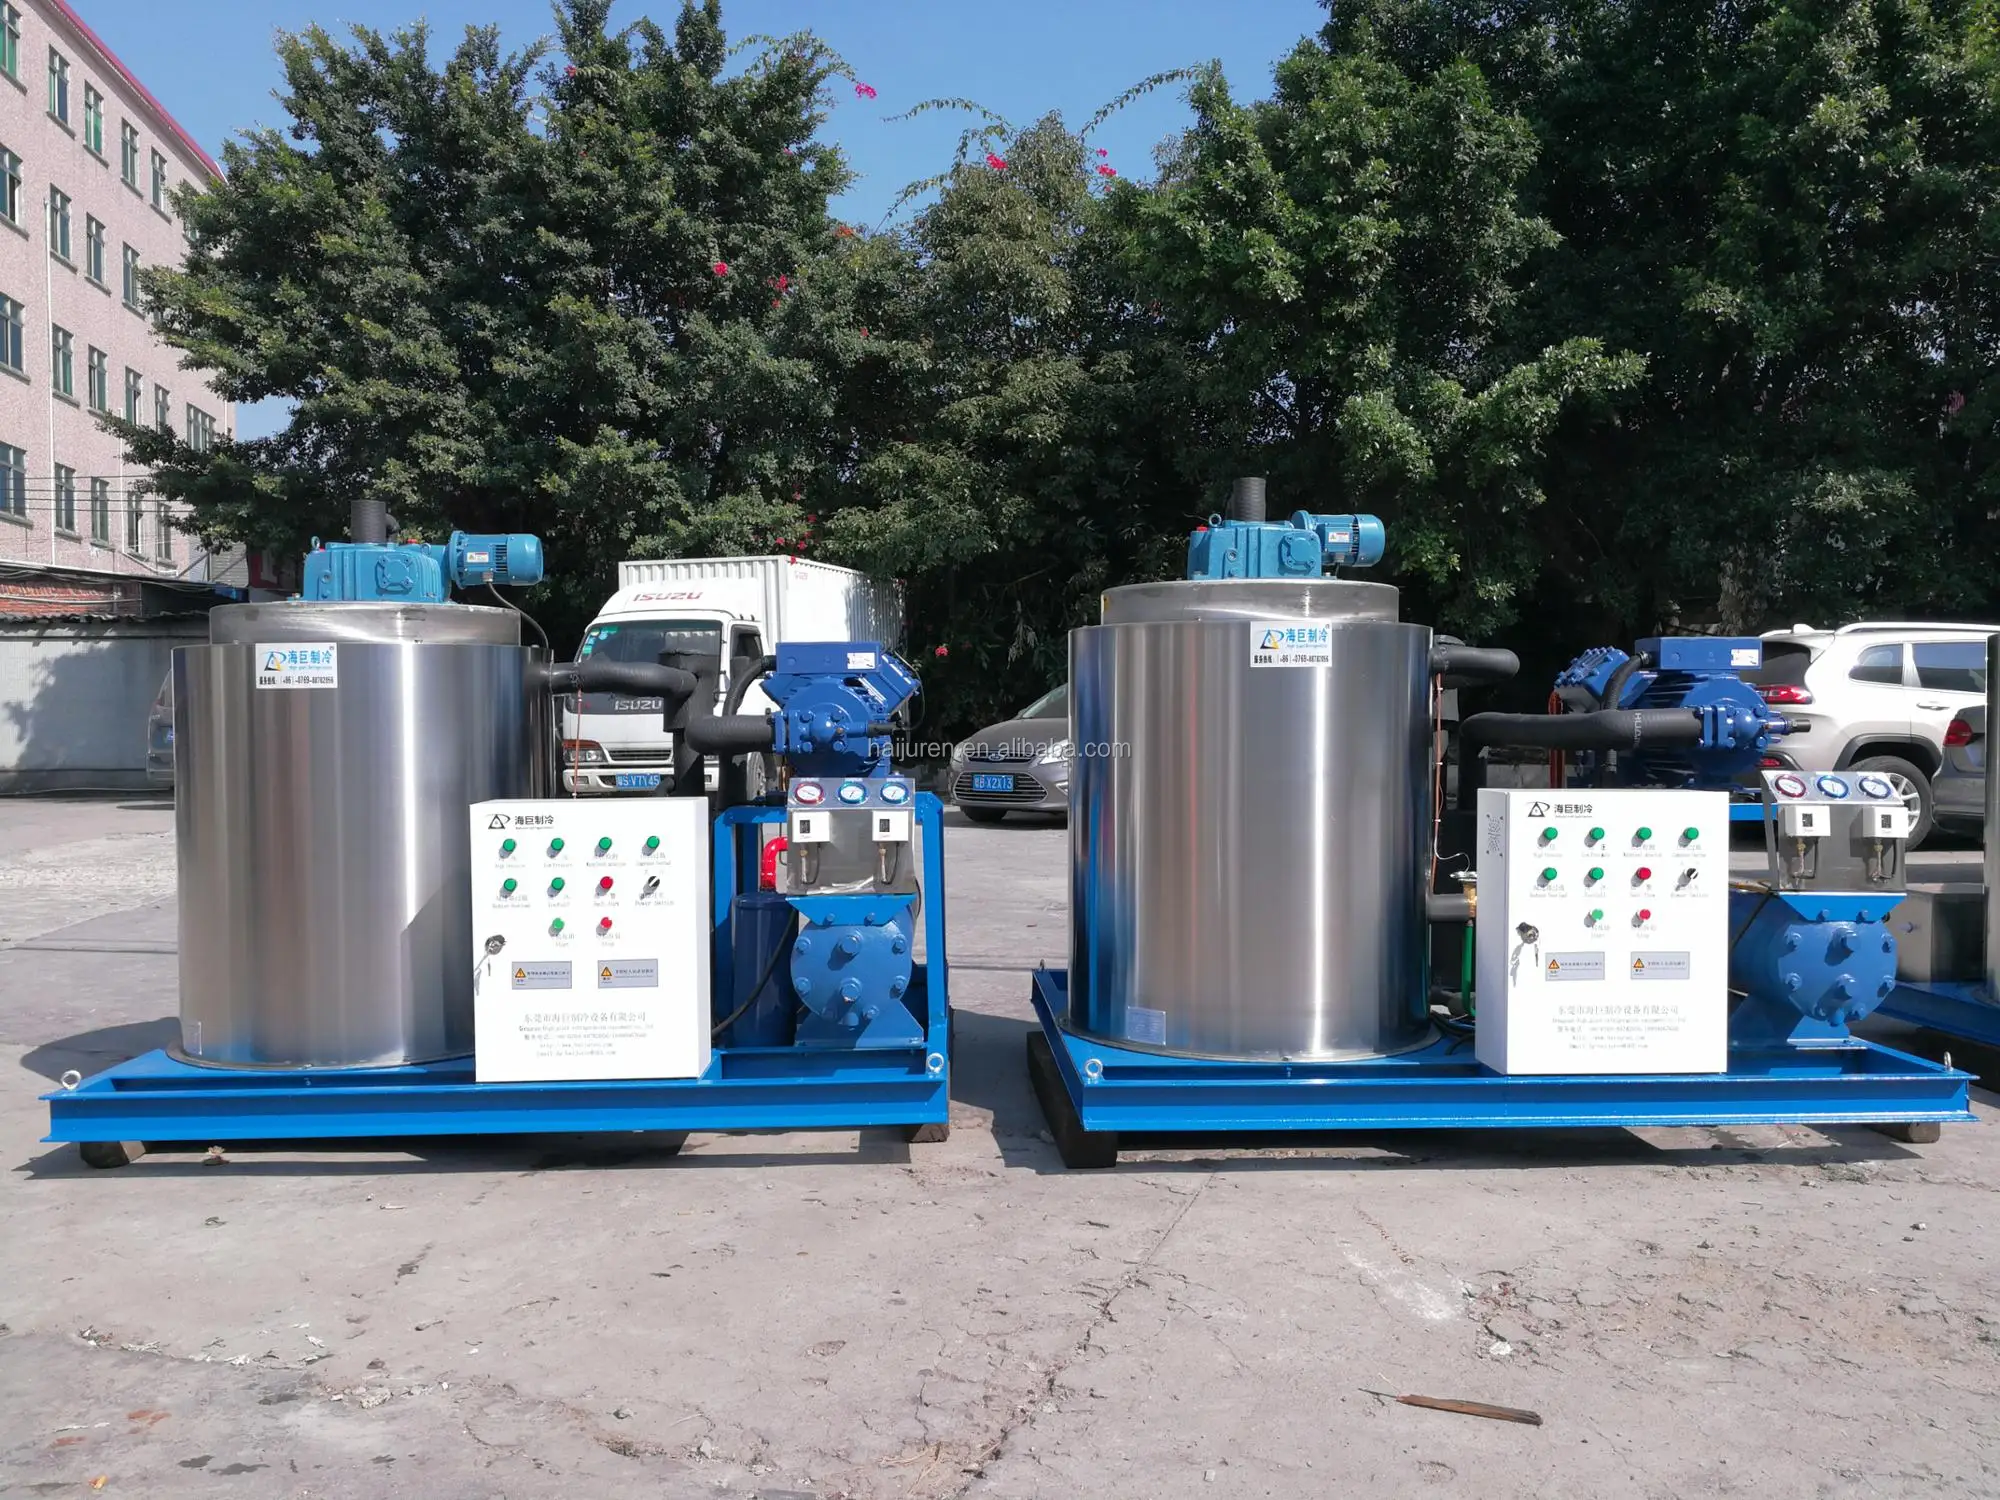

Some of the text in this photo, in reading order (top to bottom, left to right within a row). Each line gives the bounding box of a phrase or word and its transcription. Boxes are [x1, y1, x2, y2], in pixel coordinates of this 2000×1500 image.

[633, 591, 703, 602] ISUZU
[1286, 628, 1328, 643] 海巨制冷
[288, 650, 332, 664] 海巨制冷
[614, 700, 662, 710] ISUZU
[1554, 804, 1593, 814] 海巨制冷
[515, 815, 554, 825] 海巨制冷
